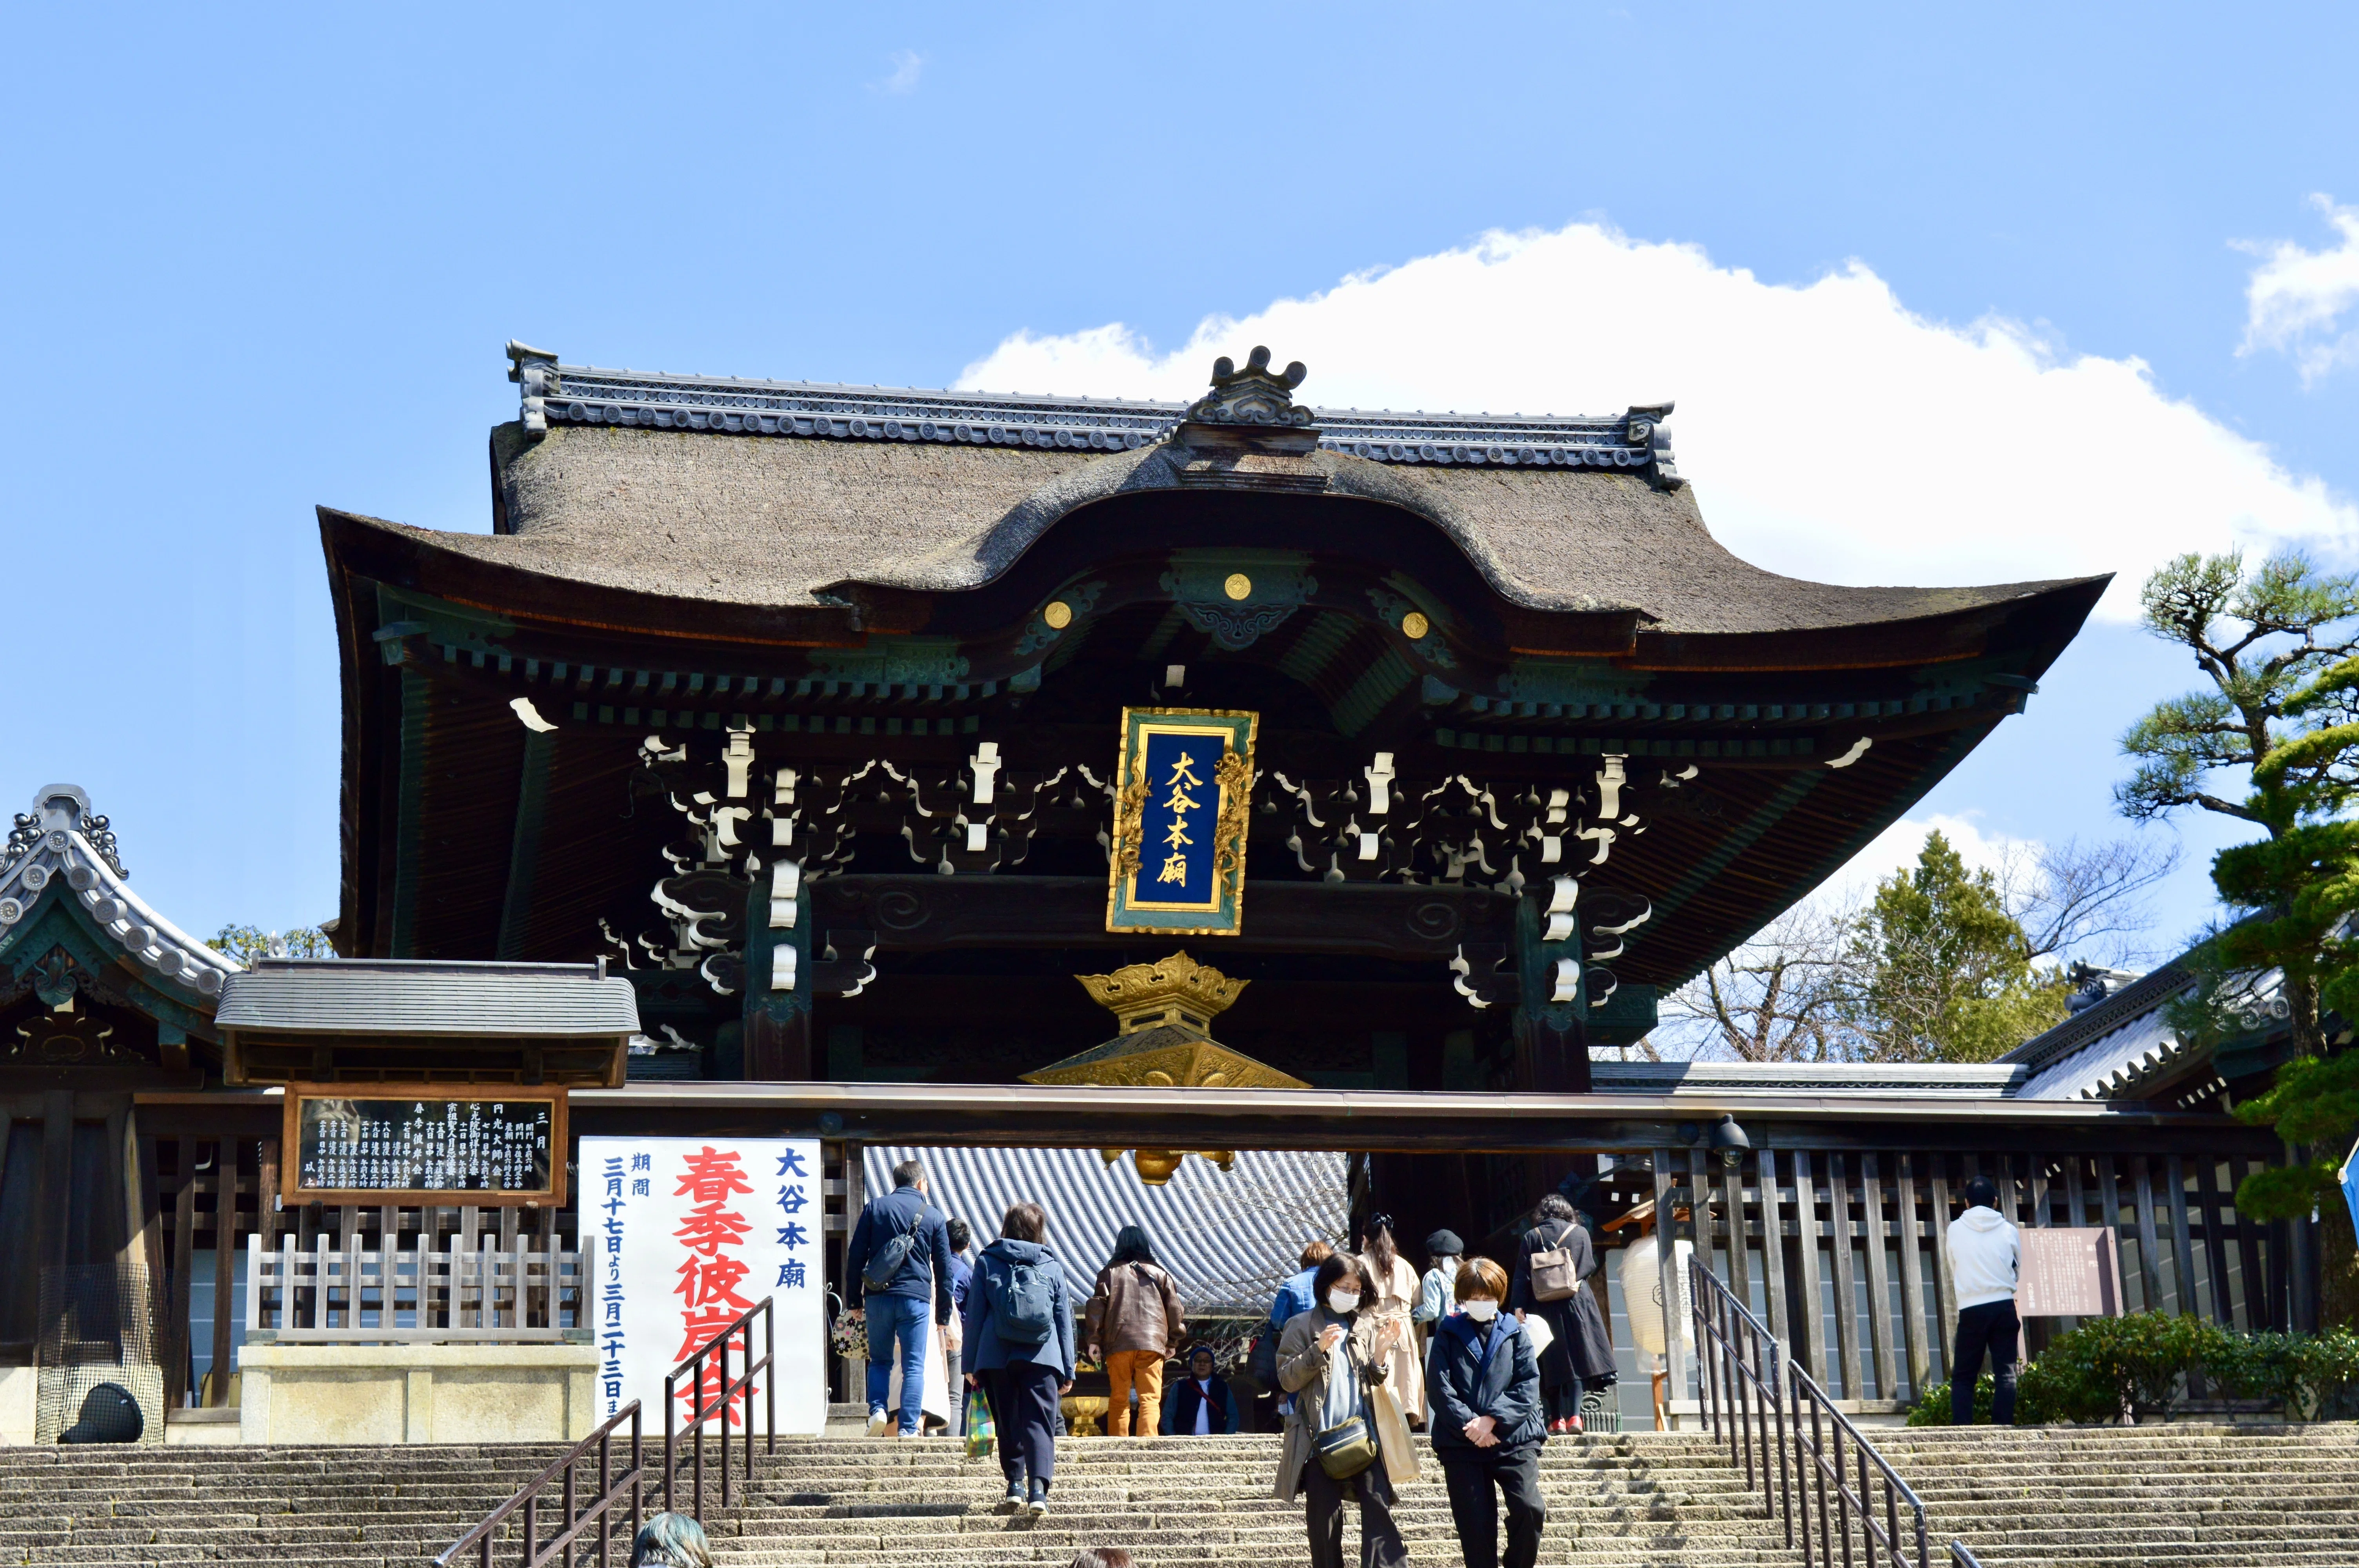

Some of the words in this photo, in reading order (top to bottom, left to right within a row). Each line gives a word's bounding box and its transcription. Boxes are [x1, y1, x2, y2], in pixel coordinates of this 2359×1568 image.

[1157, 752, 1203, 887] 大谷本廟
[403, 1121, 412, 1139] 十七日
[412, 1102, 424, 1174] 春季彼岸会
[426, 1121, 434, 1139] 十六日
[437, 1121, 445, 1139] 十五日
[446, 1102, 458, 1176] 宗祖聖人月忌法要
[459, 1122, 467, 1139] 十一日
[469, 1103, 481, 1176] 心光院御祥月法要
[482, 1122, 490, 1140] 七日
[492, 1104, 503, 1176] 円光大師会
[536, 1112, 549, 1149] 三月
[318, 1141, 326, 1155] 日中
[361, 1142, 369, 1155] 日中
[402, 1142, 411, 1156] 日中
[425, 1142, 434, 1156] 日中
[458, 1143, 467, 1156] 日中
[482, 1143, 490, 1156] 日中
[524, 1143, 533, 1172] 午前六時
[304, 1161, 315, 1186] 以上
[316, 1158, 326, 1187] 午前九時
[327, 1158, 336, 1187] 午後二時
[359, 1159, 368, 1187] 午前九時
[370, 1159, 379, 1187] 午後二時
[381, 1159, 390, 1188] 午後二時
[391, 1159, 400, 1188] 午後二時
[401, 1159, 411, 1188] 午前九時
[425, 1160, 434, 1188] 午前十時
[434, 1160, 444, 1188] 午後二時
[458, 1160, 467, 1188] 午前十時
[480, 1160, 490, 1188] 午前十時
[631, 1152, 651, 1198] 期間
[776, 1148, 809, 1289] 大谷本廟
[601, 1156, 626, 1418] 三月十七日より三月二十三日ま
[672, 1146, 760, 1426] 春季彼岸会
